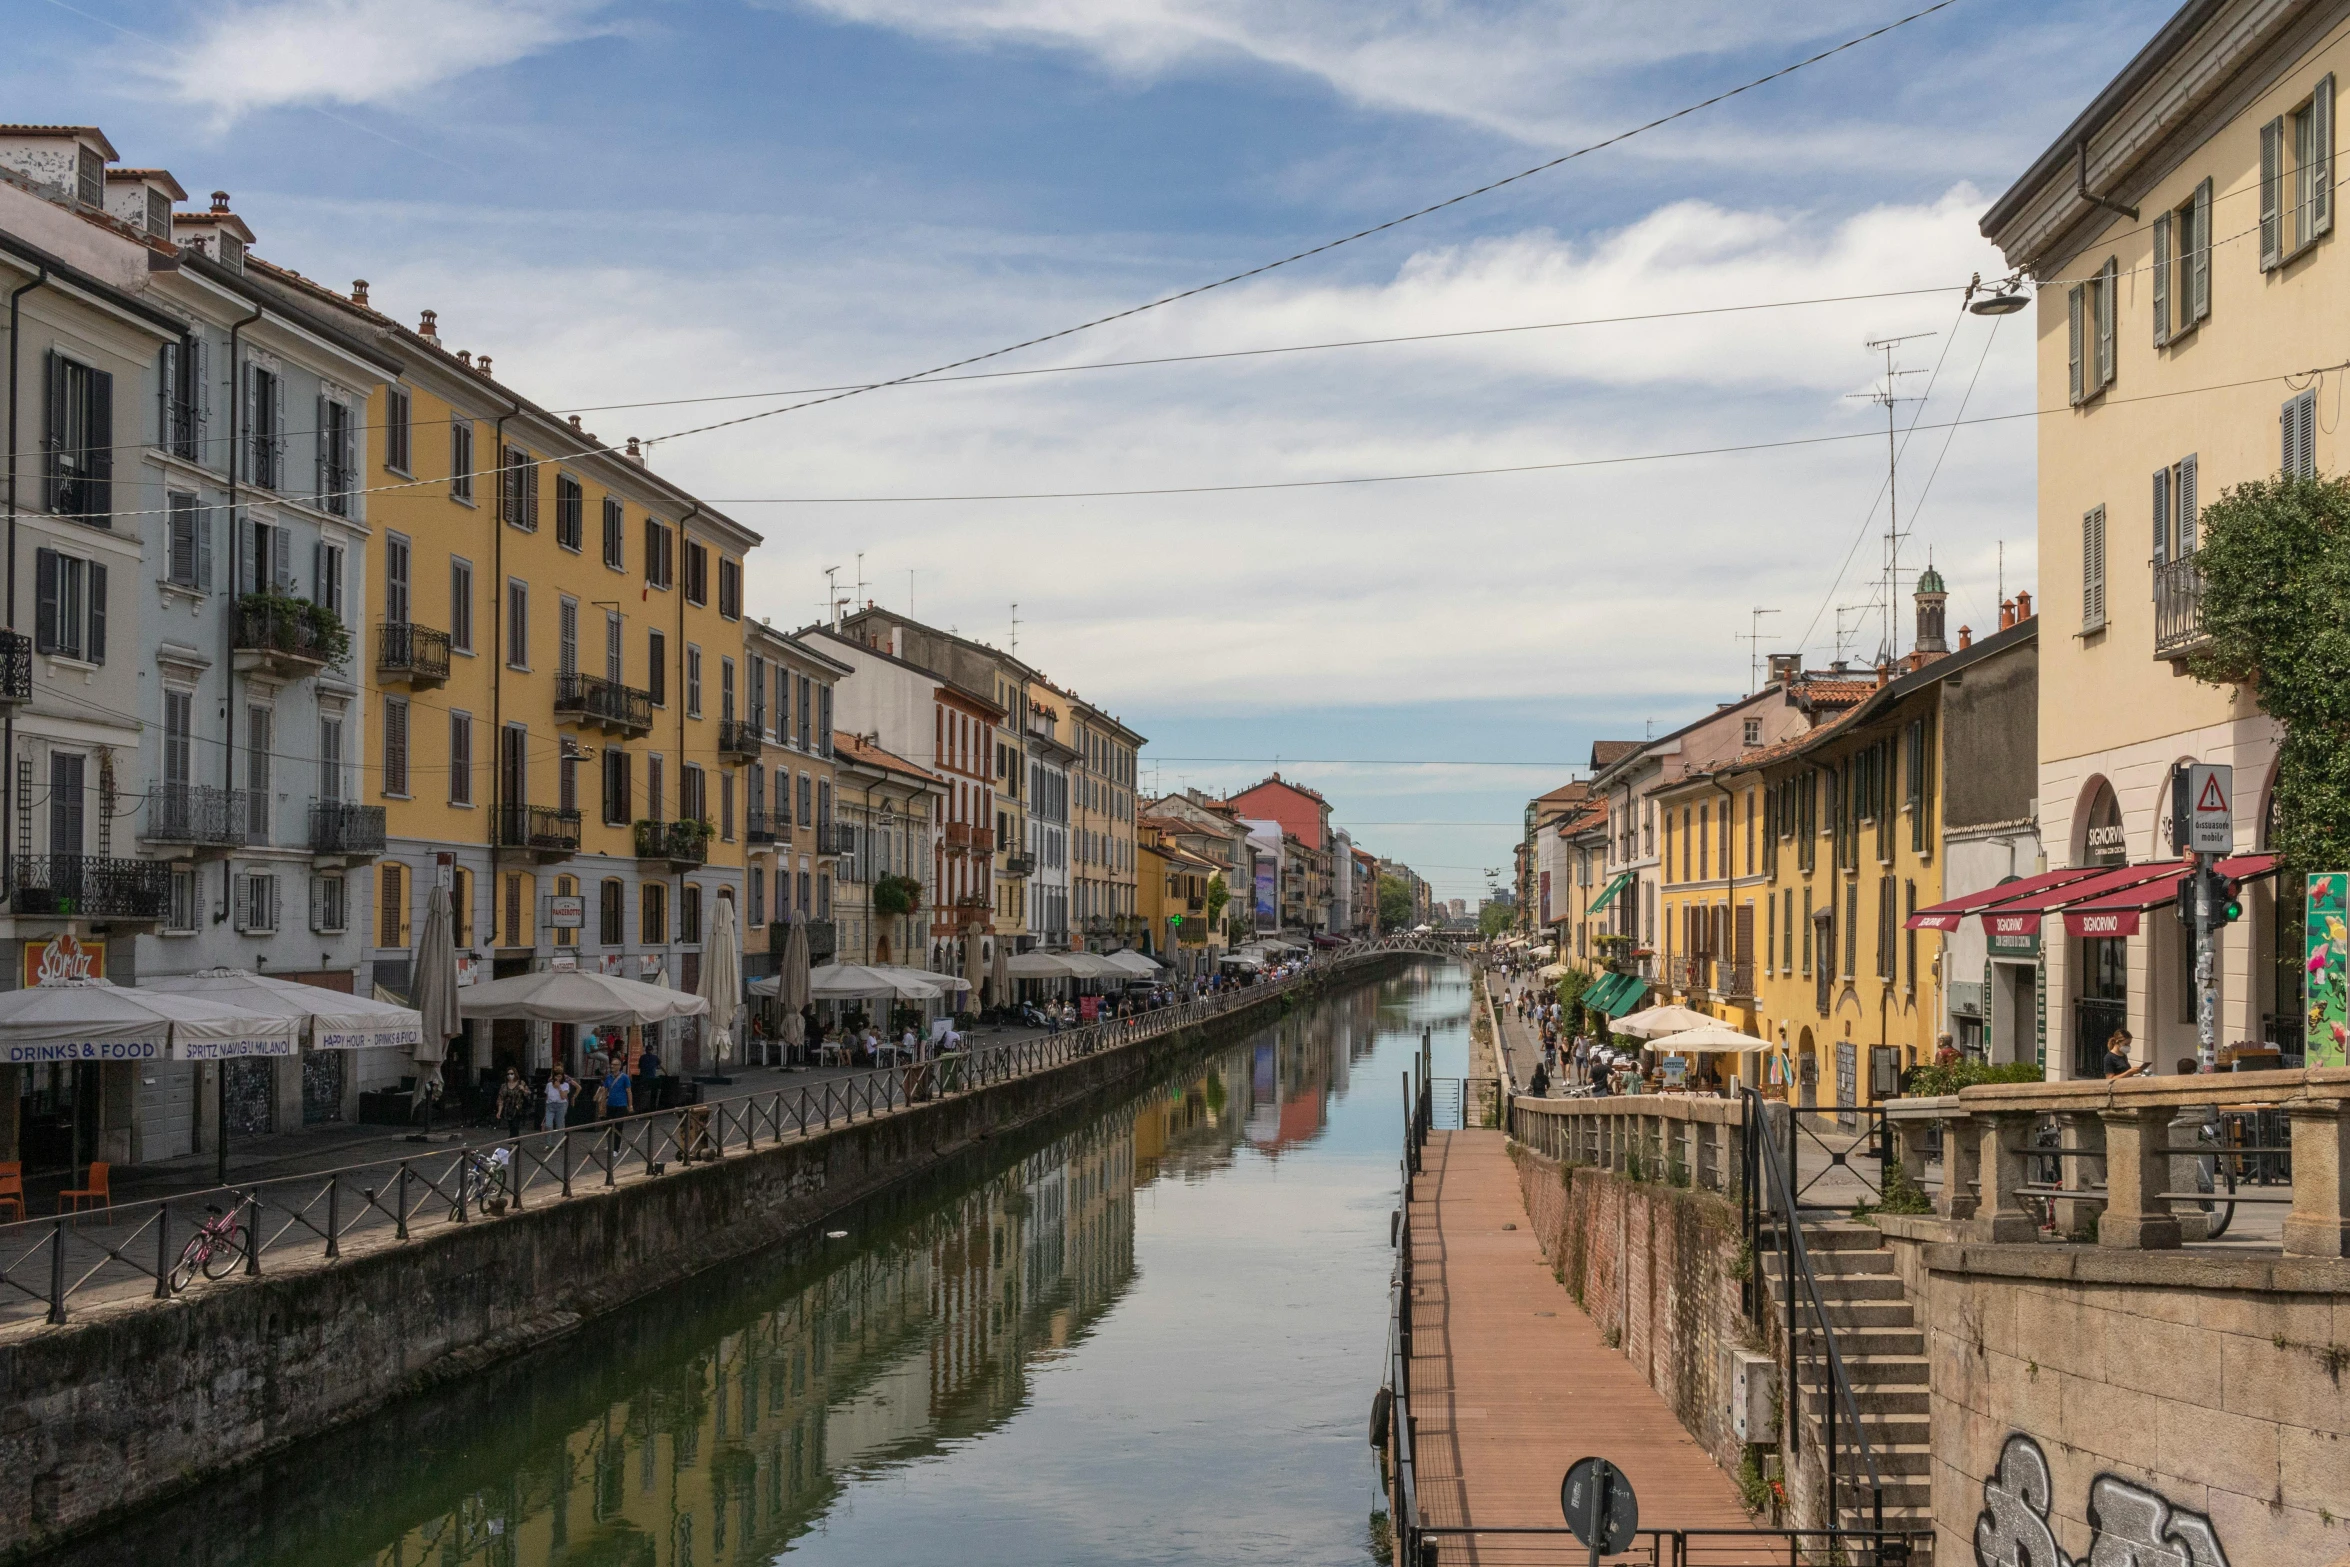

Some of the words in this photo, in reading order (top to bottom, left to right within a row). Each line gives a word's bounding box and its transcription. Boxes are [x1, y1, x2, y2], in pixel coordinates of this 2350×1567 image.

[2195, 821, 2230, 830] dissuasore
[2201, 832, 2224, 842] mobile
[552, 908, 581, 916] PANZEROTTO
[1917, 916, 1946, 927] SIGNORVINO
[1996, 917, 2023, 932] SIGNORVINO
[2083, 915, 2117, 932] SIGNORVINO
[323, 1034, 345, 1047] HAPPY
[346, 1034, 365, 1047] HOUR
[374, 1032, 395, 1046] DRINKS
[11, 1043, 78, 1061] DRINKS
[82, 1042, 95, 1058] &
[101, 1042, 155, 1058] FOOD
[186, 1043, 218, 1058] SPRITZ
[255, 1040, 288, 1055] MILANO
